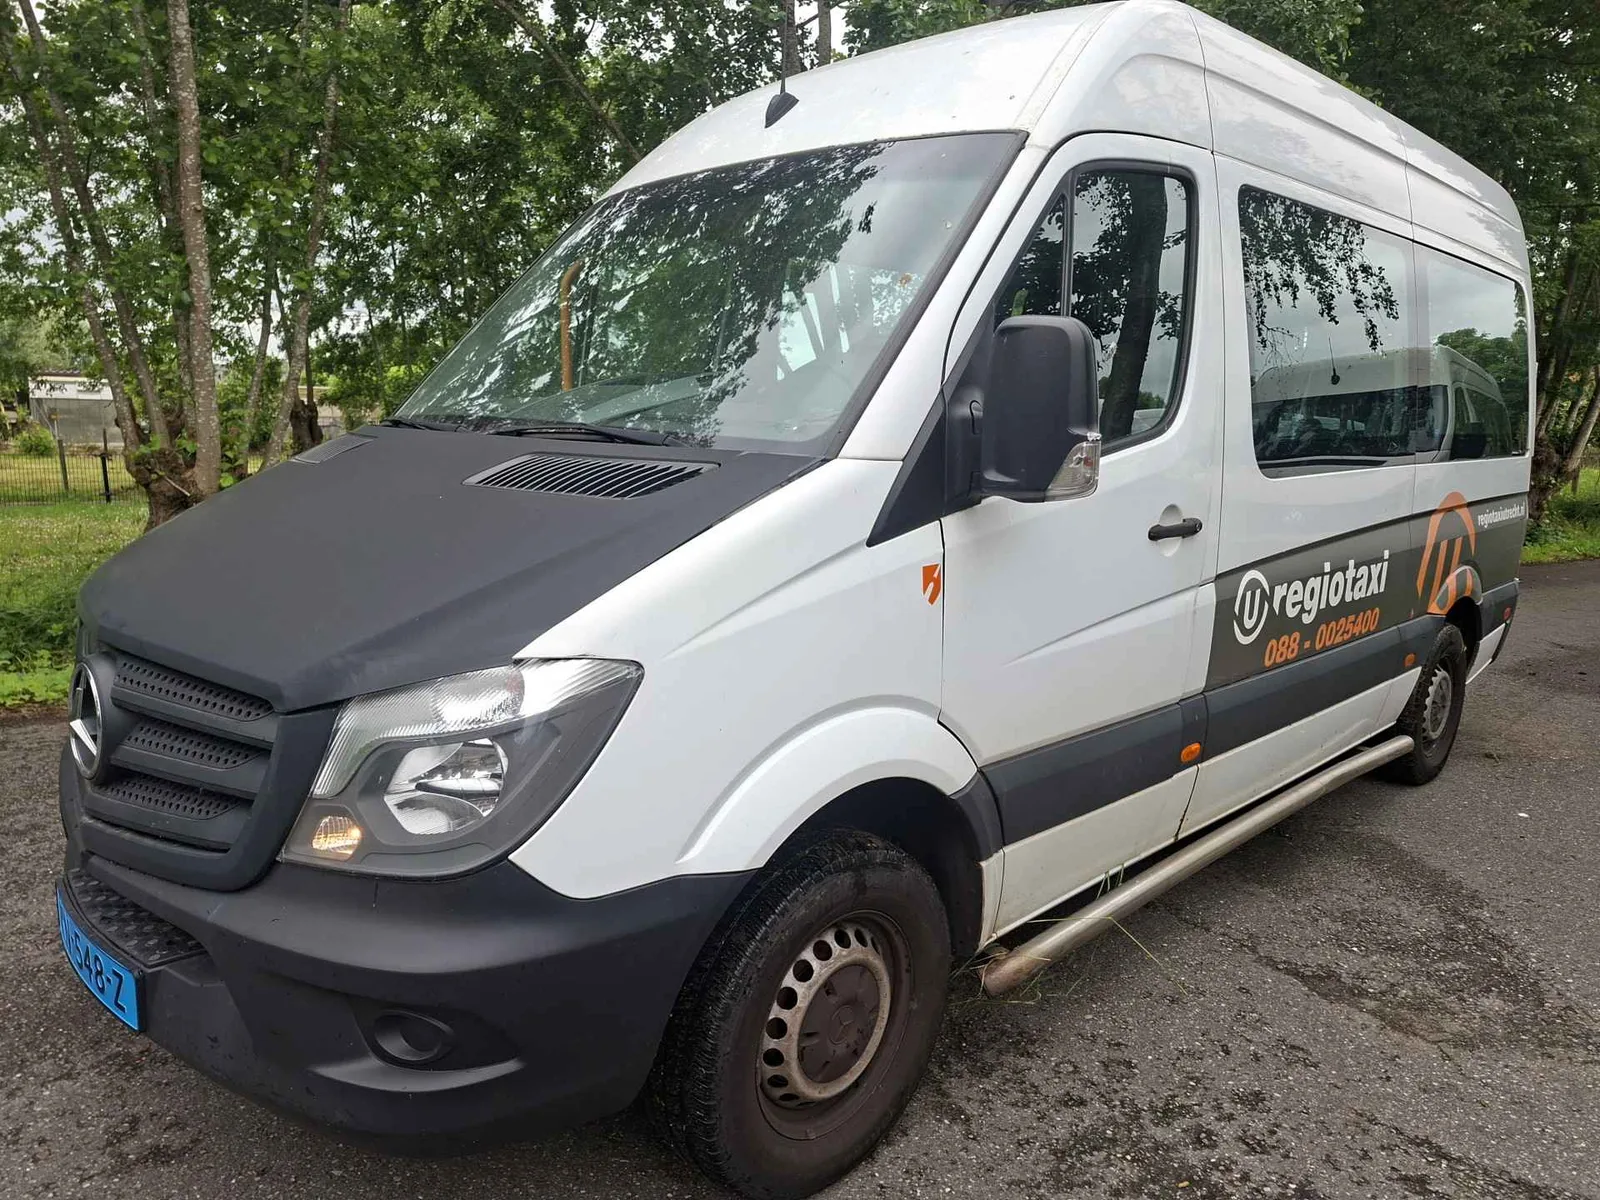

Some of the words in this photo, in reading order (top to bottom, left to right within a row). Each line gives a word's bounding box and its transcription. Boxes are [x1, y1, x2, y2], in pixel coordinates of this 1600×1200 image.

[1272, 549, 1390, 625] regiotaxi
[1263, 631, 1301, 668] 088
[1315, 607, 1380, 651] 0025400
